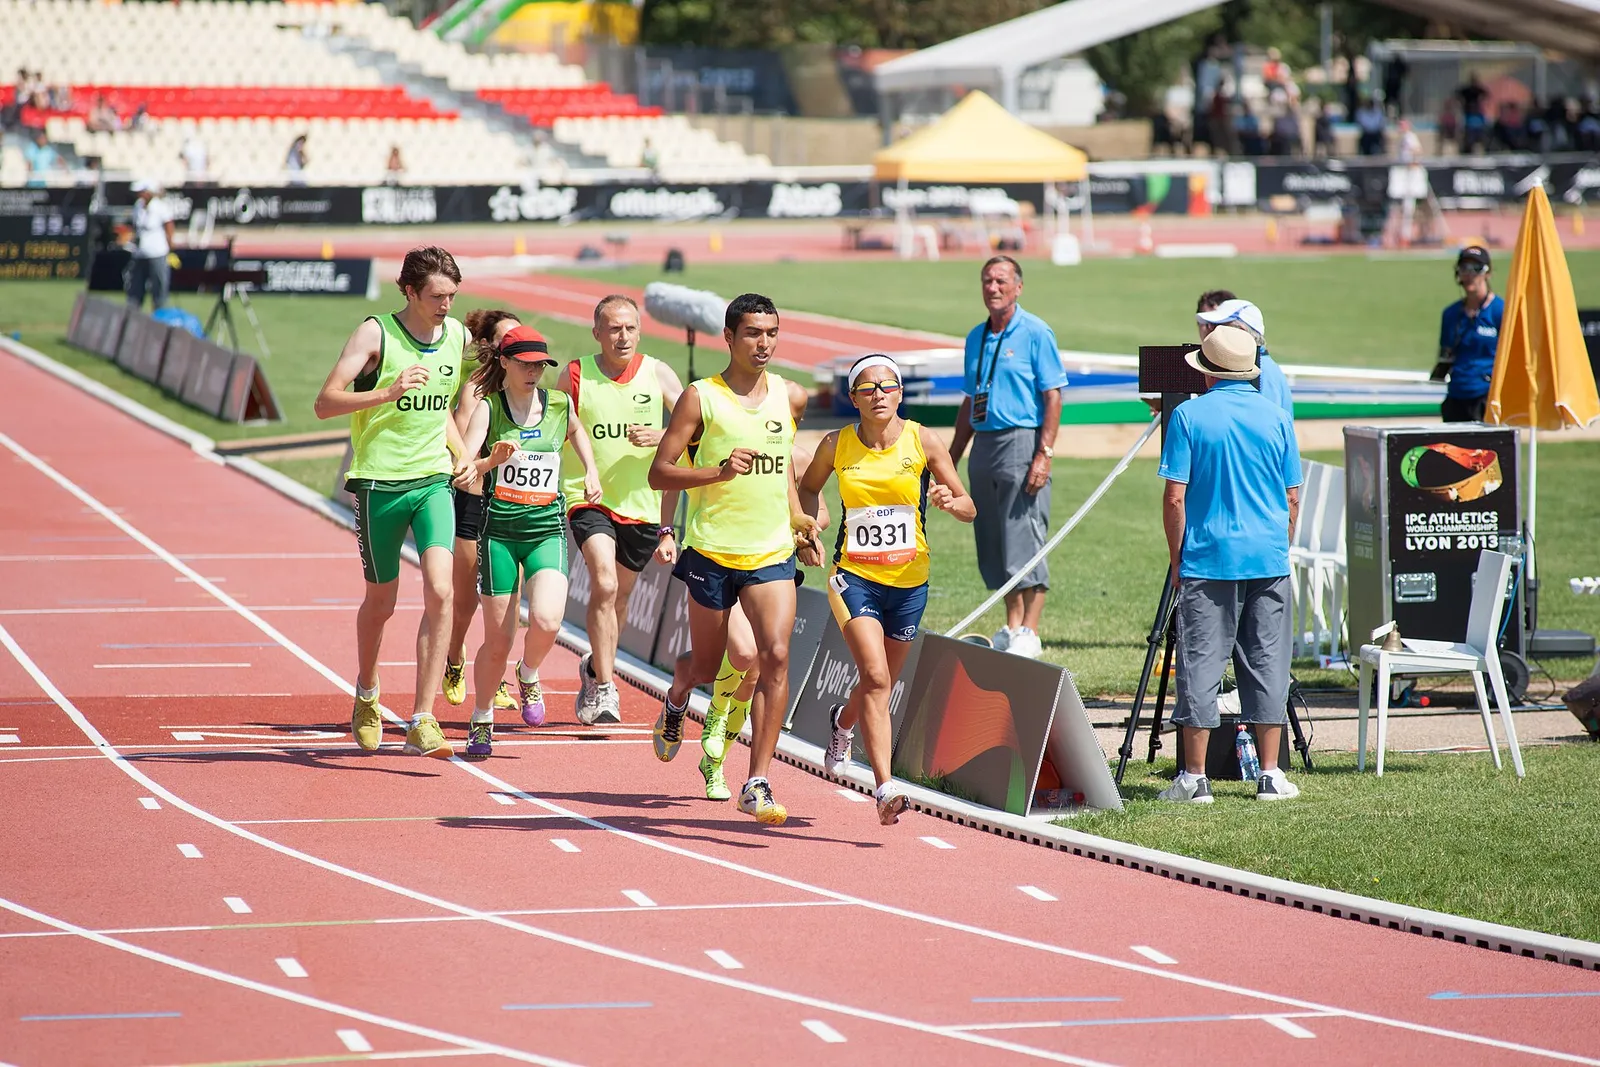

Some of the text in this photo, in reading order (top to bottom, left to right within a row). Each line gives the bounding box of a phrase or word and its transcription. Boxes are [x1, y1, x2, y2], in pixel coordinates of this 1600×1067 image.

[396, 394, 450, 412] GUIDE
[592, 423, 652, 440] GUI
[503, 464, 554, 488] 0587
[1405, 511, 1499, 525] IPC ATHLETICS
[856, 522, 907, 547] 0331
[1405, 523, 1498, 533] WORLD CHAMPIONSHIPS
[1405, 535, 1499, 550] LYON 2013
